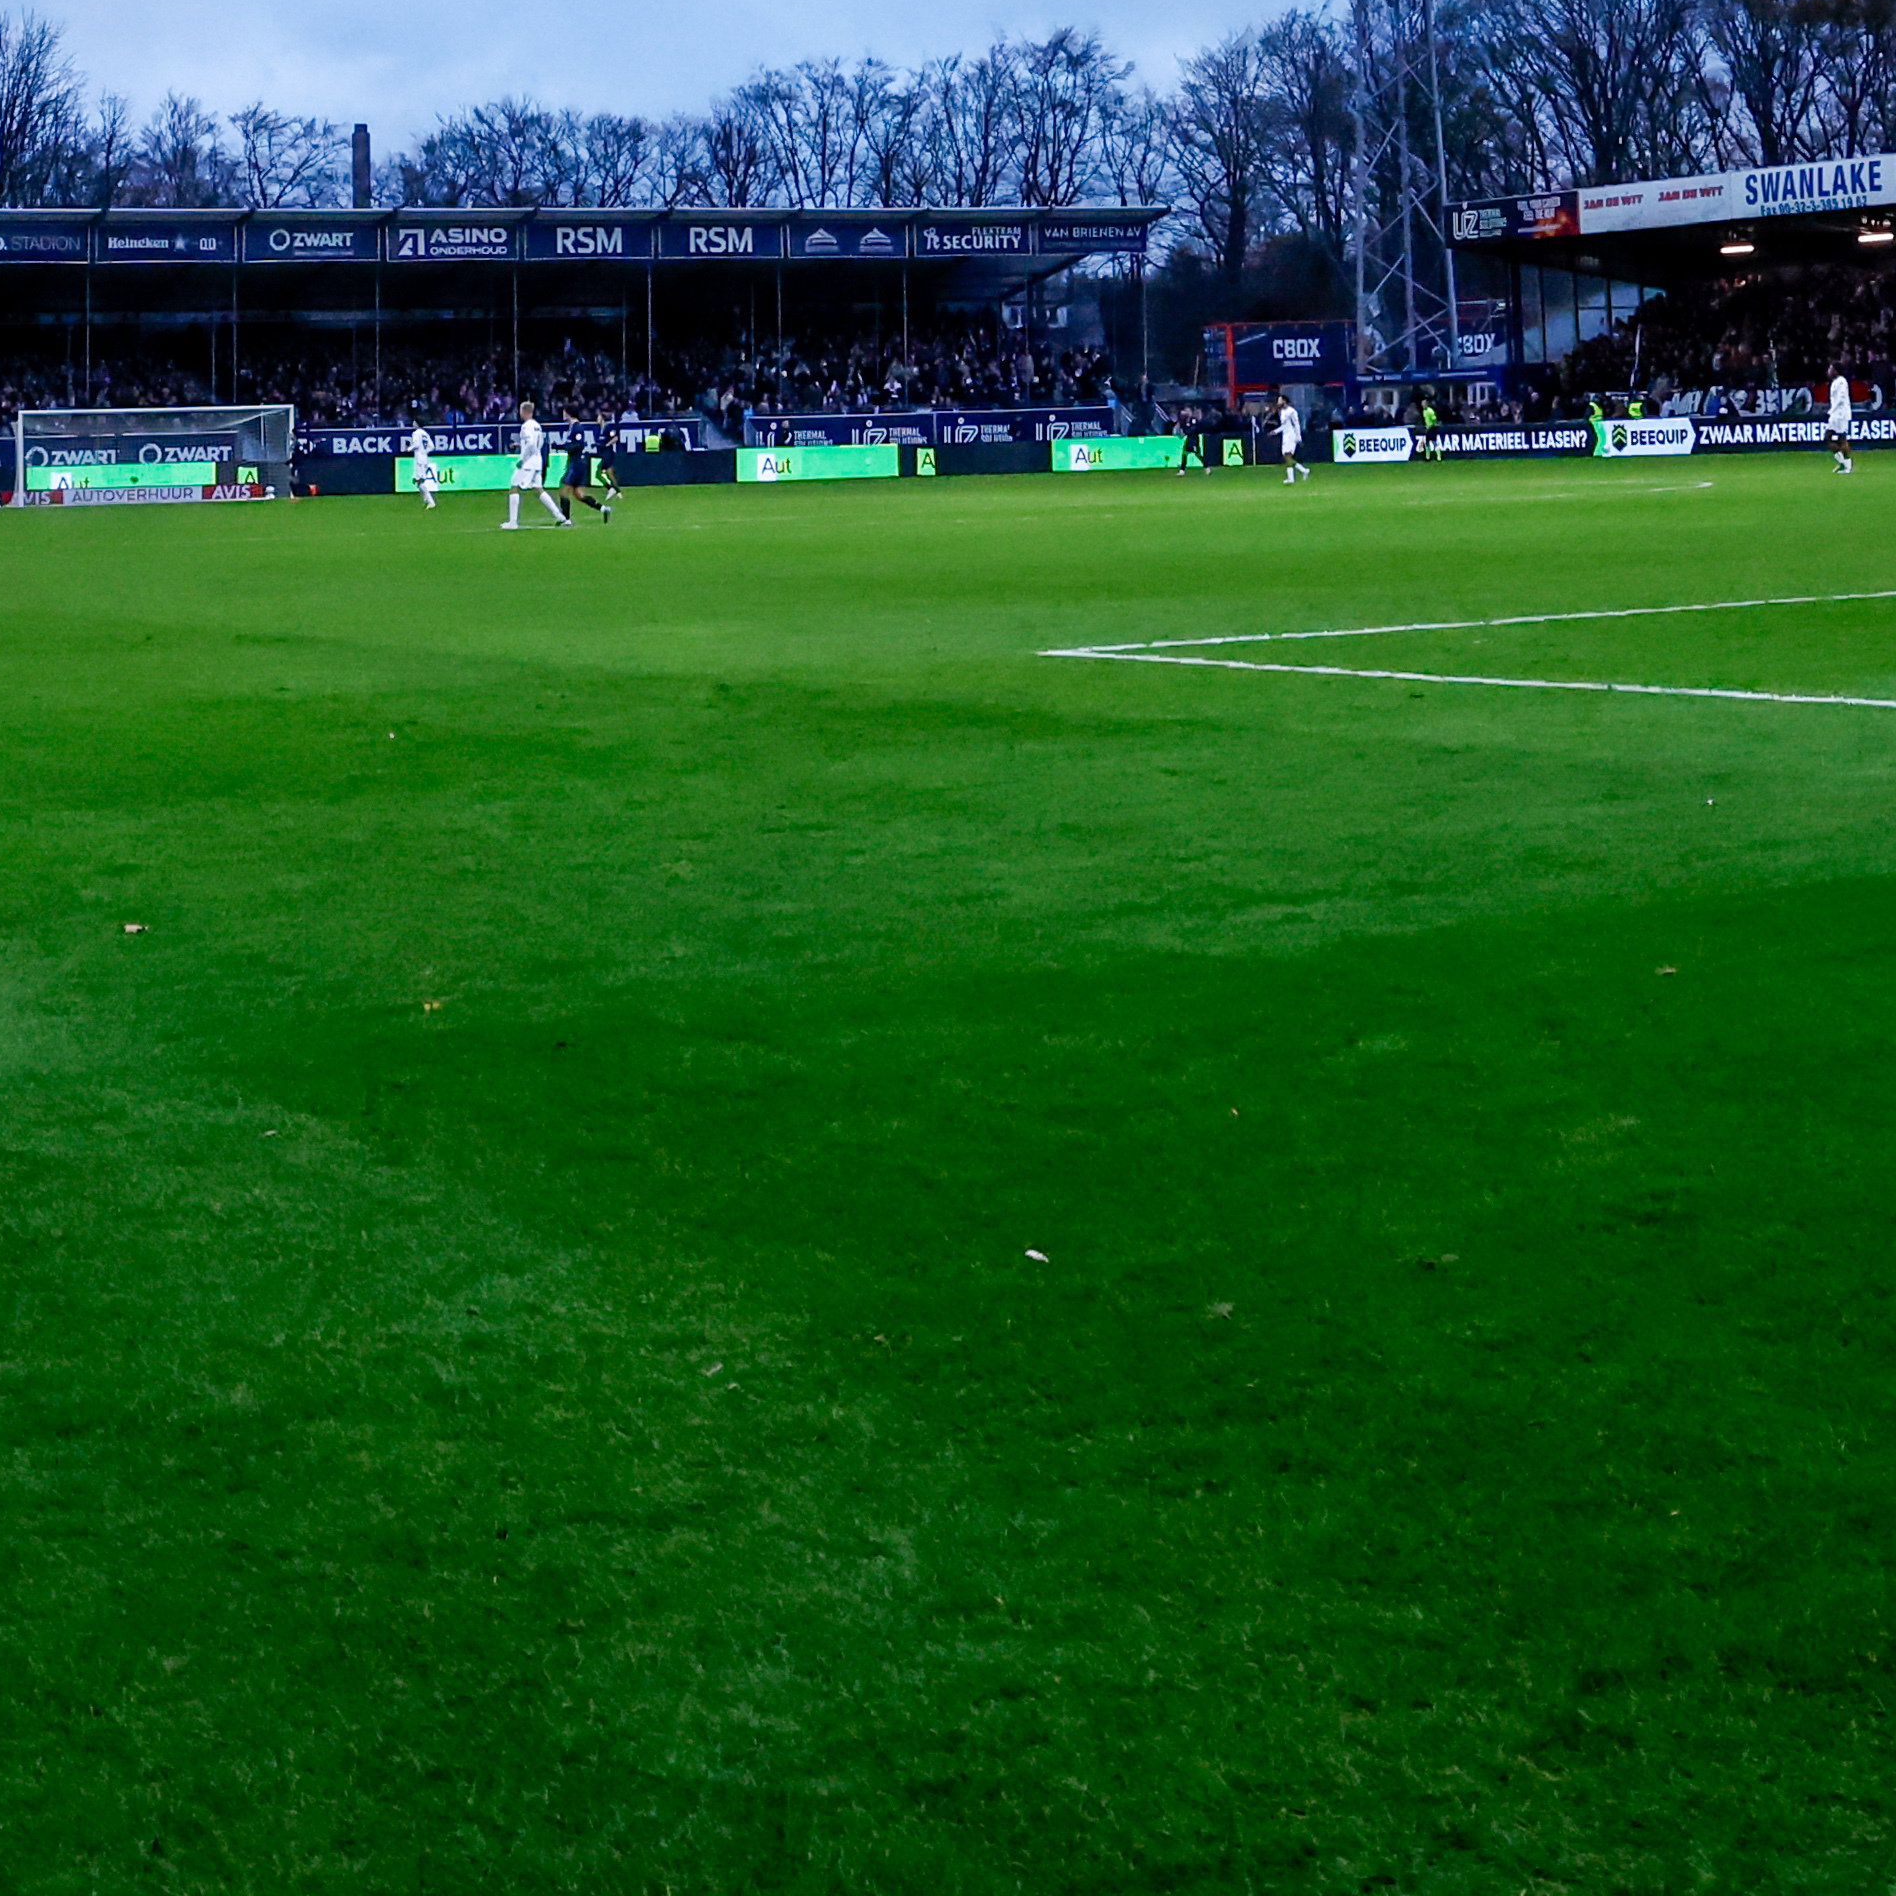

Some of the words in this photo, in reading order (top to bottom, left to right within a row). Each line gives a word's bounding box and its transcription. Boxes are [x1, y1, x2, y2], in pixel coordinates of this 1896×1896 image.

[1746, 161, 1882, 205] SWANLAKE
[293, 232, 354, 247] ZWART
[430, 227, 508, 244] ASINO
[689, 226, 754, 253] RSM
[1044, 226, 1069, 238] VAN
[1073, 226, 1125, 238] BRIENEN
[11, 236, 81, 251] STADION
[107, 237, 169, 250] Heineken
[556, 227, 623, 254] RSM
[943, 236, 1021, 251] SECURITY
[430, 246, 508, 255] ONDERHOUD
[1272, 339, 1321, 358] CBOX
[1359, 438, 1406, 452] BEEQUIP
[1462, 432, 1529, 451] MATERIEEL
[1532, 430, 1587, 449] LEASEN?
[1630, 429, 1688, 446] BEEQUIP
[1700, 424, 1753, 444] ZWAAR
[1756, 423, 1825, 443] MATERIE
[333, 436, 392, 454] BACK
[434, 433, 492, 452] BACK
[1228, 443, 1243, 458] A
[51, 450, 117, 465] ZWART
[164, 446, 232, 462] ZWART
[921, 453, 935, 468] A
[1075, 448, 1102, 463] Aut
[762, 458, 792, 473] Aut
[72, 487, 193, 502] AUTOVERHUUR
[212, 485, 250, 499] AVIS
